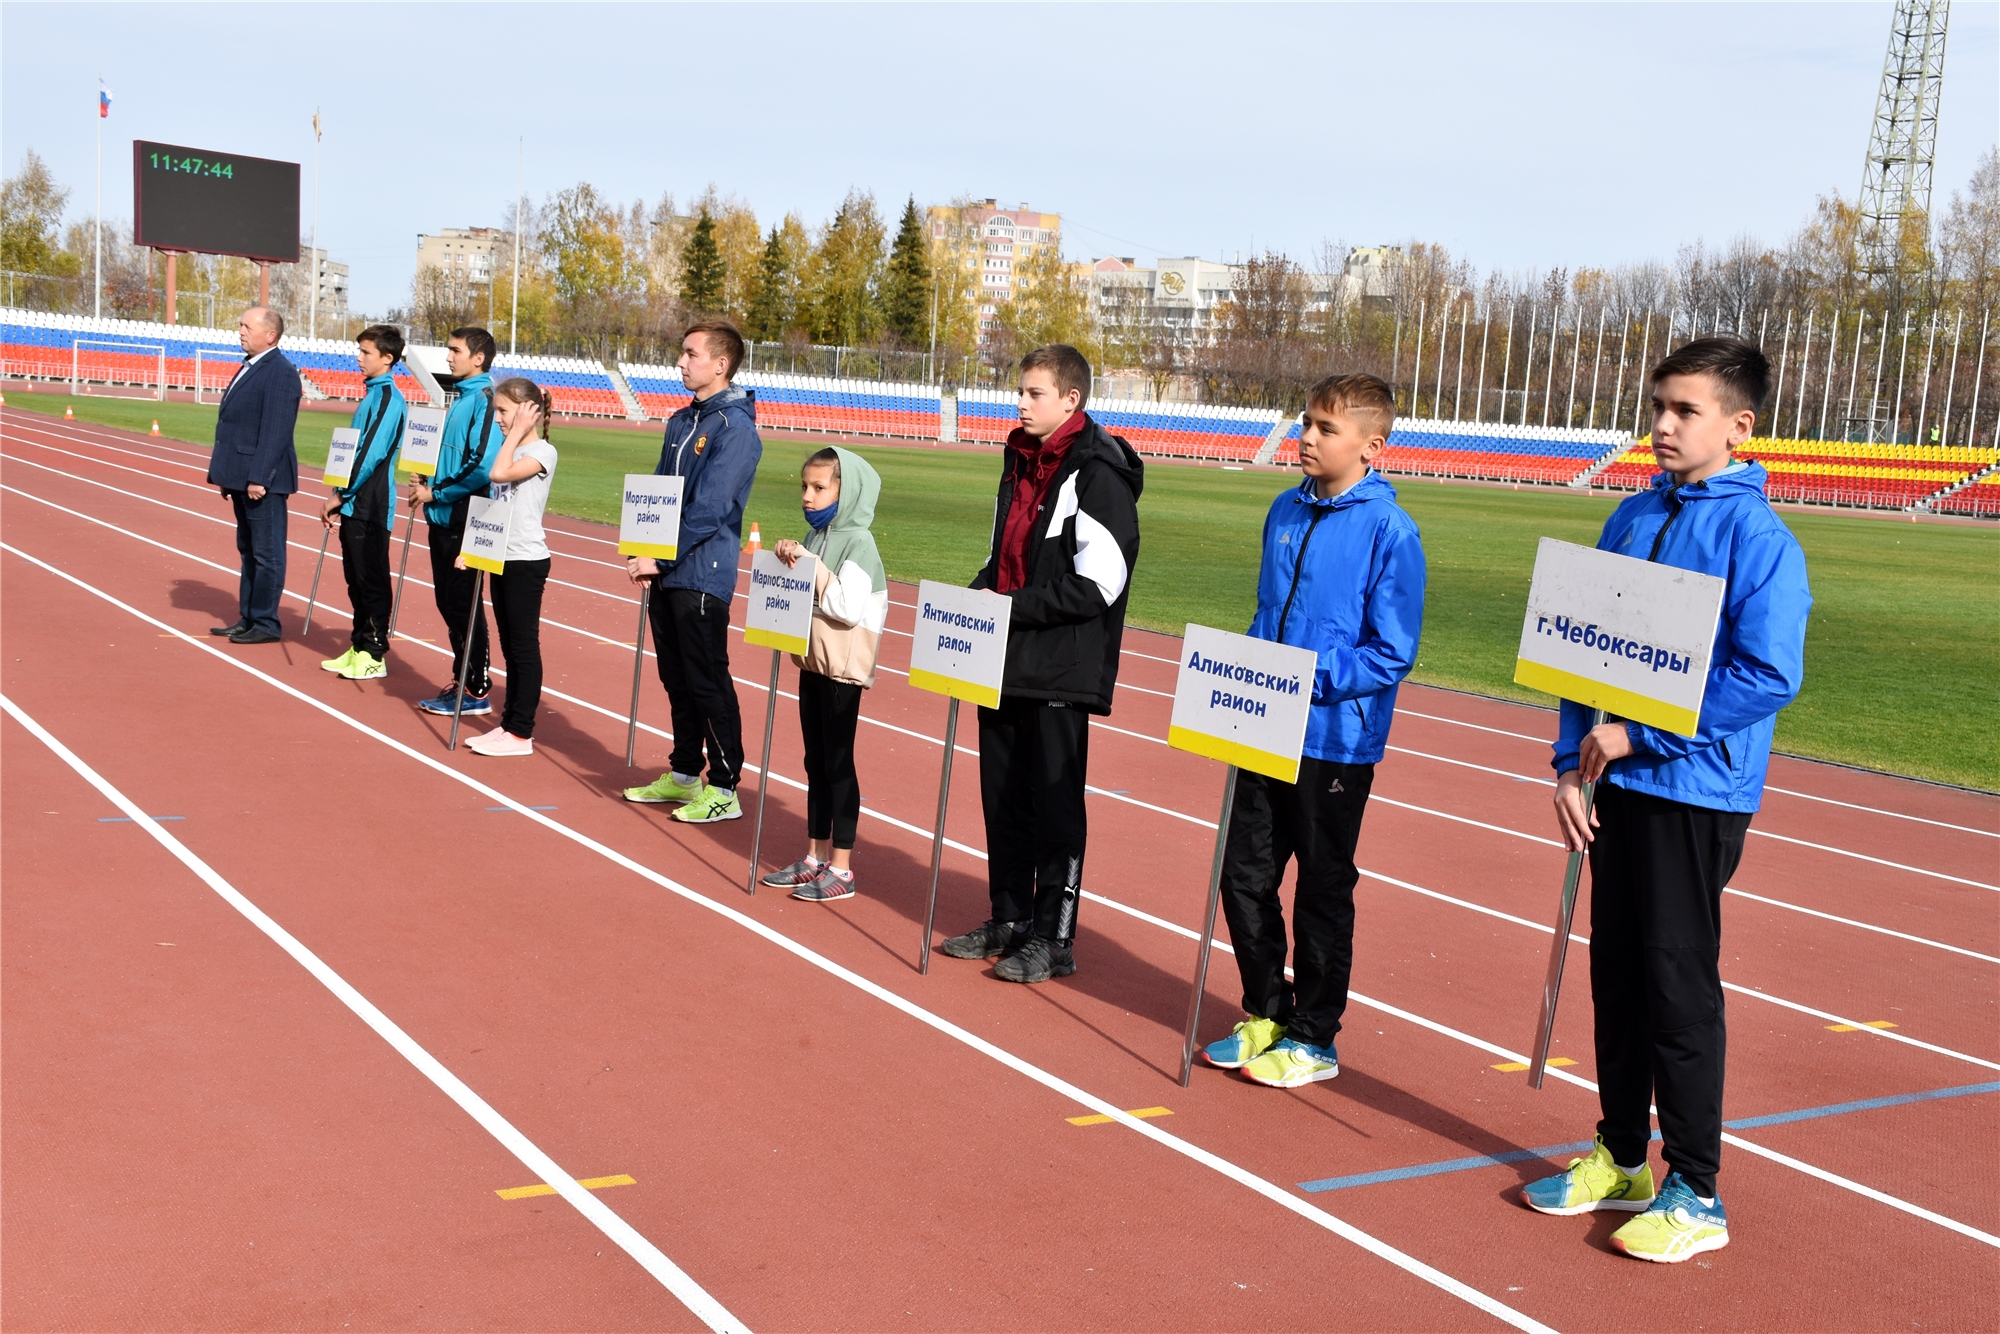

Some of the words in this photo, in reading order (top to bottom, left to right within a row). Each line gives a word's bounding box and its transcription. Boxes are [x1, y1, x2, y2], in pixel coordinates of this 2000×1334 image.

[150, 153, 233, 179] 11:47:44
[408, 420, 438, 433] Канашский
[412, 436, 428, 447] район
[470, 516, 504, 534] Ядринский
[637, 510, 660, 525] район
[474, 535, 493, 548] район
[766, 595, 790, 611] район
[922, 603, 995, 634] Янтиковский
[1537, 615, 1691, 674] г.Чебоксары
[1188, 651, 1300, 695] Аликовский
